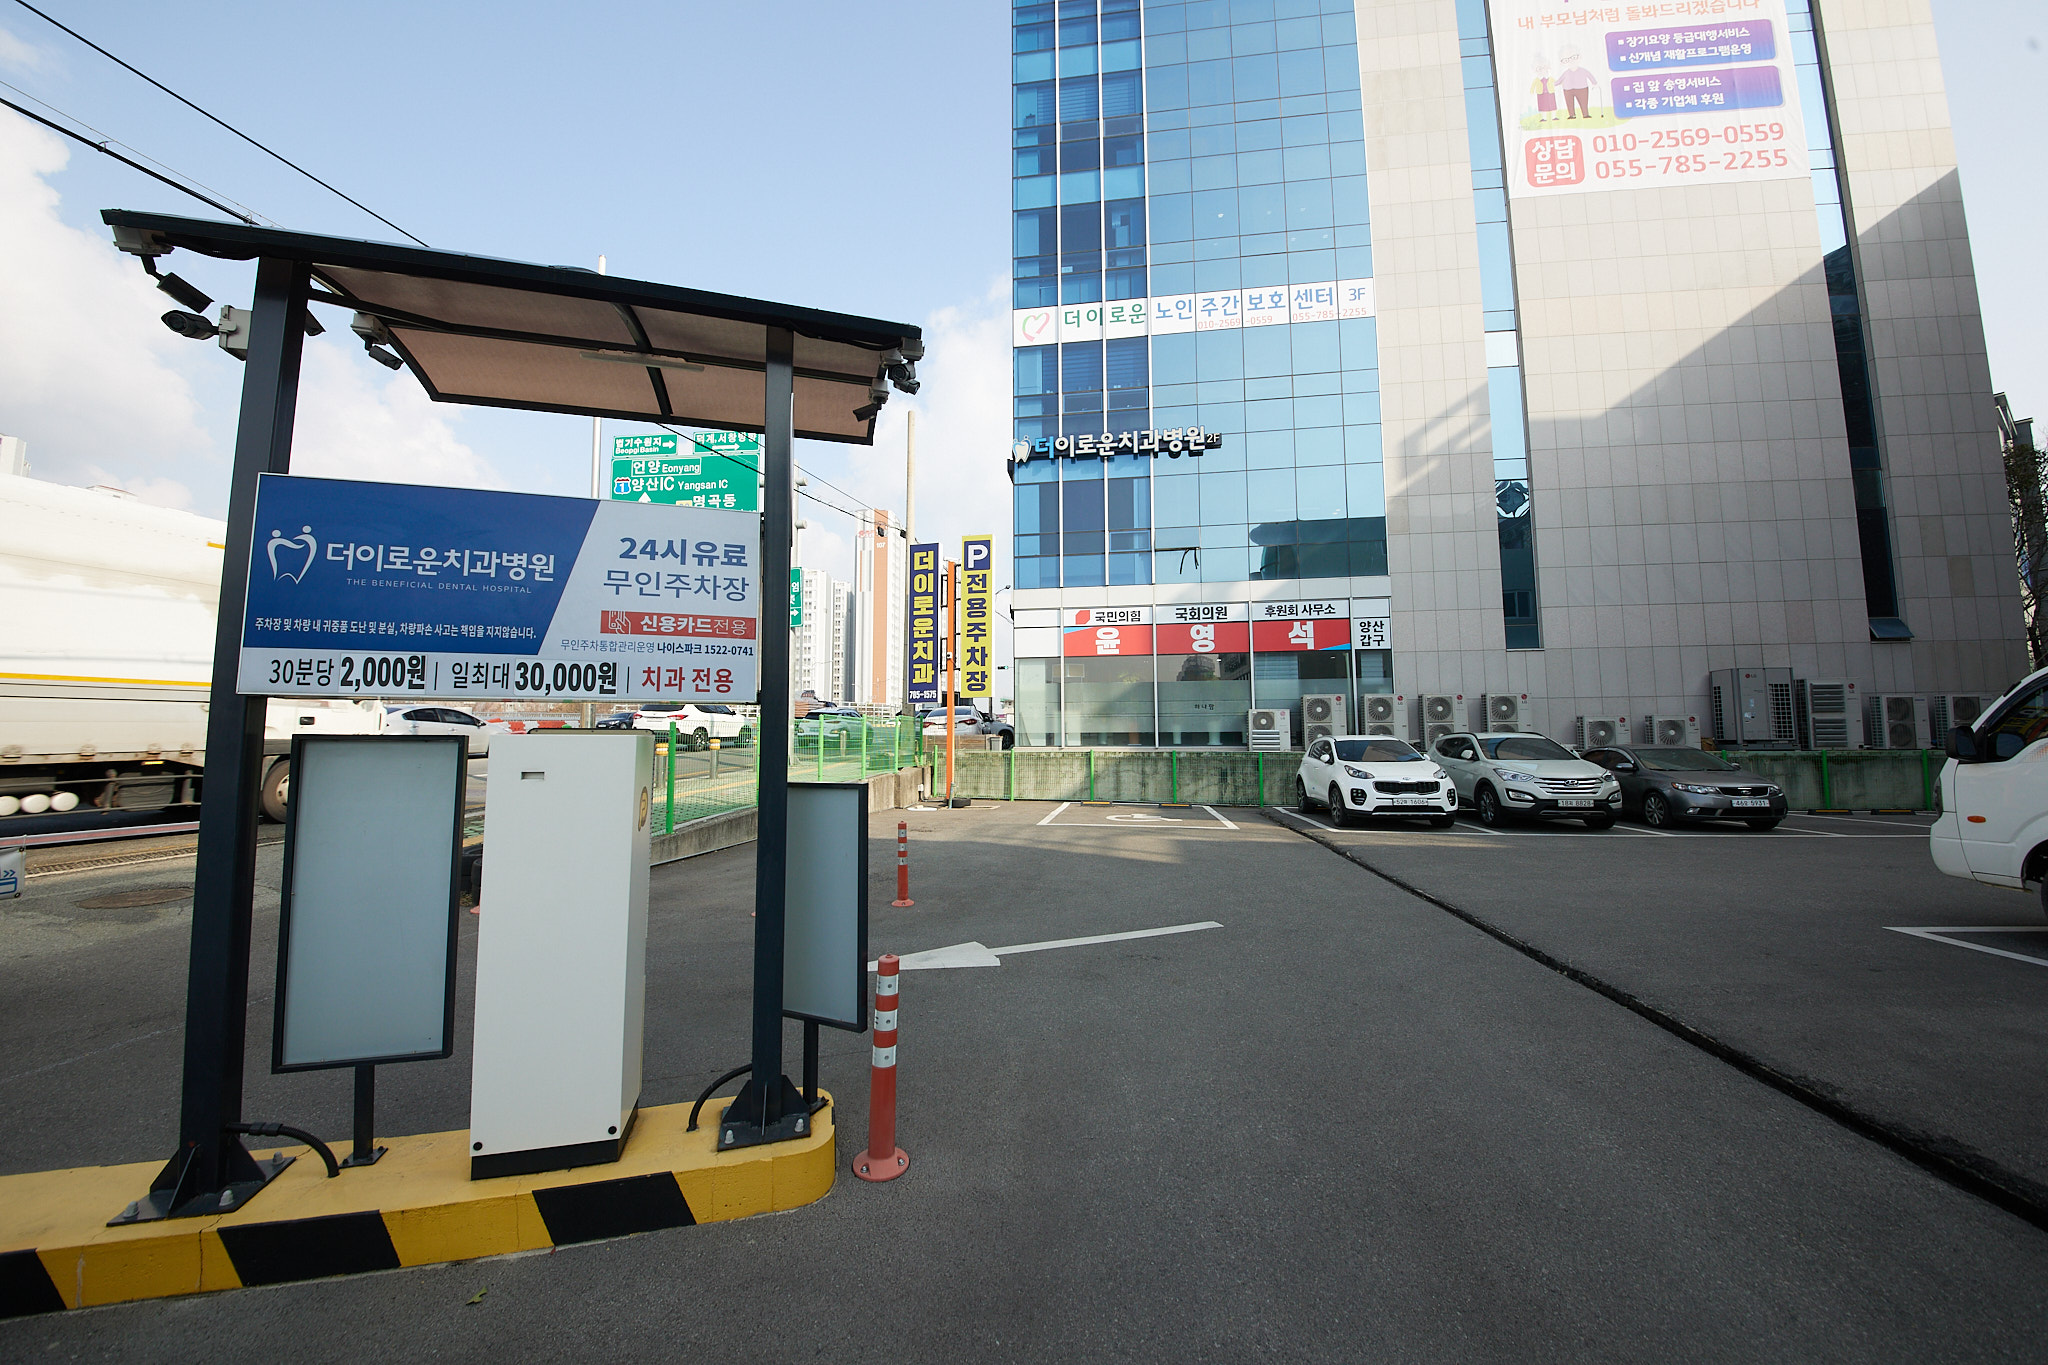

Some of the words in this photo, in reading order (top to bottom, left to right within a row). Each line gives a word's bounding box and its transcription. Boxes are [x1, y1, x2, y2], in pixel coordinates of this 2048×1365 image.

[1518, 16, 1534, 29] 내
[1540, 7, 1620, 29] 부모님처럼
[1626, 33, 1670, 48] 장기요양
[1672, 27, 1751, 44] 등급대행서비스
[1628, 50, 1662, 64] 신개념
[1663, 43, 1752, 60] 재활프로그램운영
[1632, 81, 1645, 93] 집
[1647, 80, 1660, 92] 앞
[1663, 76, 1722, 91] 송영서비스
[1634, 97, 1659, 110] 각종
[1661, 94, 1698, 107] 기업체
[1700, 93, 1725, 105] 후원
[1592, 122, 1784, 153] 010-2569-0559
[1531, 138, 1576, 161] 상담
[1533, 161, 1577, 184] 문의
[1595, 148, 1788, 179] 055-785-2255
[1064, 303, 1147, 328] 더이로운
[1348, 288, 1366, 301] 3F
[1292, 308, 1367, 322] 055-785-2255
[1034, 426, 1206, 459] 더이로운치과병원
[1206, 433, 1220, 443] 2F
[632, 460, 661, 475] 언양
[662, 463, 701, 475] Eonyang
[631, 477, 675, 491] 양산IC
[678, 481, 716, 492] Yangsan
[718, 479, 728, 489] IC
[693, 493, 737, 508] 명곡동
[326, 542, 555, 582] 더이로운치과병원
[967, 544, 989, 569] P
[346, 578, 367, 586] THE
[371, 580, 434, 589] BENEFICIAL
[438, 583, 478, 591] DENTAL
[482, 585, 532, 594] HOSPITAL
[603, 569, 750, 602] 무인주차장
[912, 550, 935, 684] 더이로운치과
[1094, 610, 1141, 622] 국민의힘
[1175, 606, 1228, 621] 국회의원
[1264, 604, 1299, 617] 후원회
[1301, 603, 1336, 616] 사무소
[255, 617, 282, 631] 주차장
[283, 618, 292, 631] 및
[293, 618, 312, 632] 차량
[312, 619, 322, 632] 내
[322, 620, 348, 633] 귀중품
[349, 621, 366, 634] 도난
[368, 621, 377, 634] 및
[378, 621, 398, 636] 분실,
[399, 622, 433, 636] 차량파손
[434, 624, 459, 637] 사고는
[460, 624, 485, 638] 책임을
[485, 625, 537, 639] 지지않습니다.
[640, 615, 747, 636] 신용카드전용
[966, 573, 989, 692] 전용주차장
[1359, 620, 1385, 633] 양산
[560, 639, 655, 653] 무인주차통합관리운영
[657, 641, 703, 655] 나이스파크
[704, 644, 754, 657] 1522-0741
[1359, 634, 1385, 647] 갑구
[268, 657, 335, 686] 30분당
[340, 655, 427, 692] 2,000원
[451, 660, 510, 690] 일최대
[514, 662, 618, 696] 30,000원
[641, 665, 686, 693] 치과
[691, 667, 734, 693] 전용
